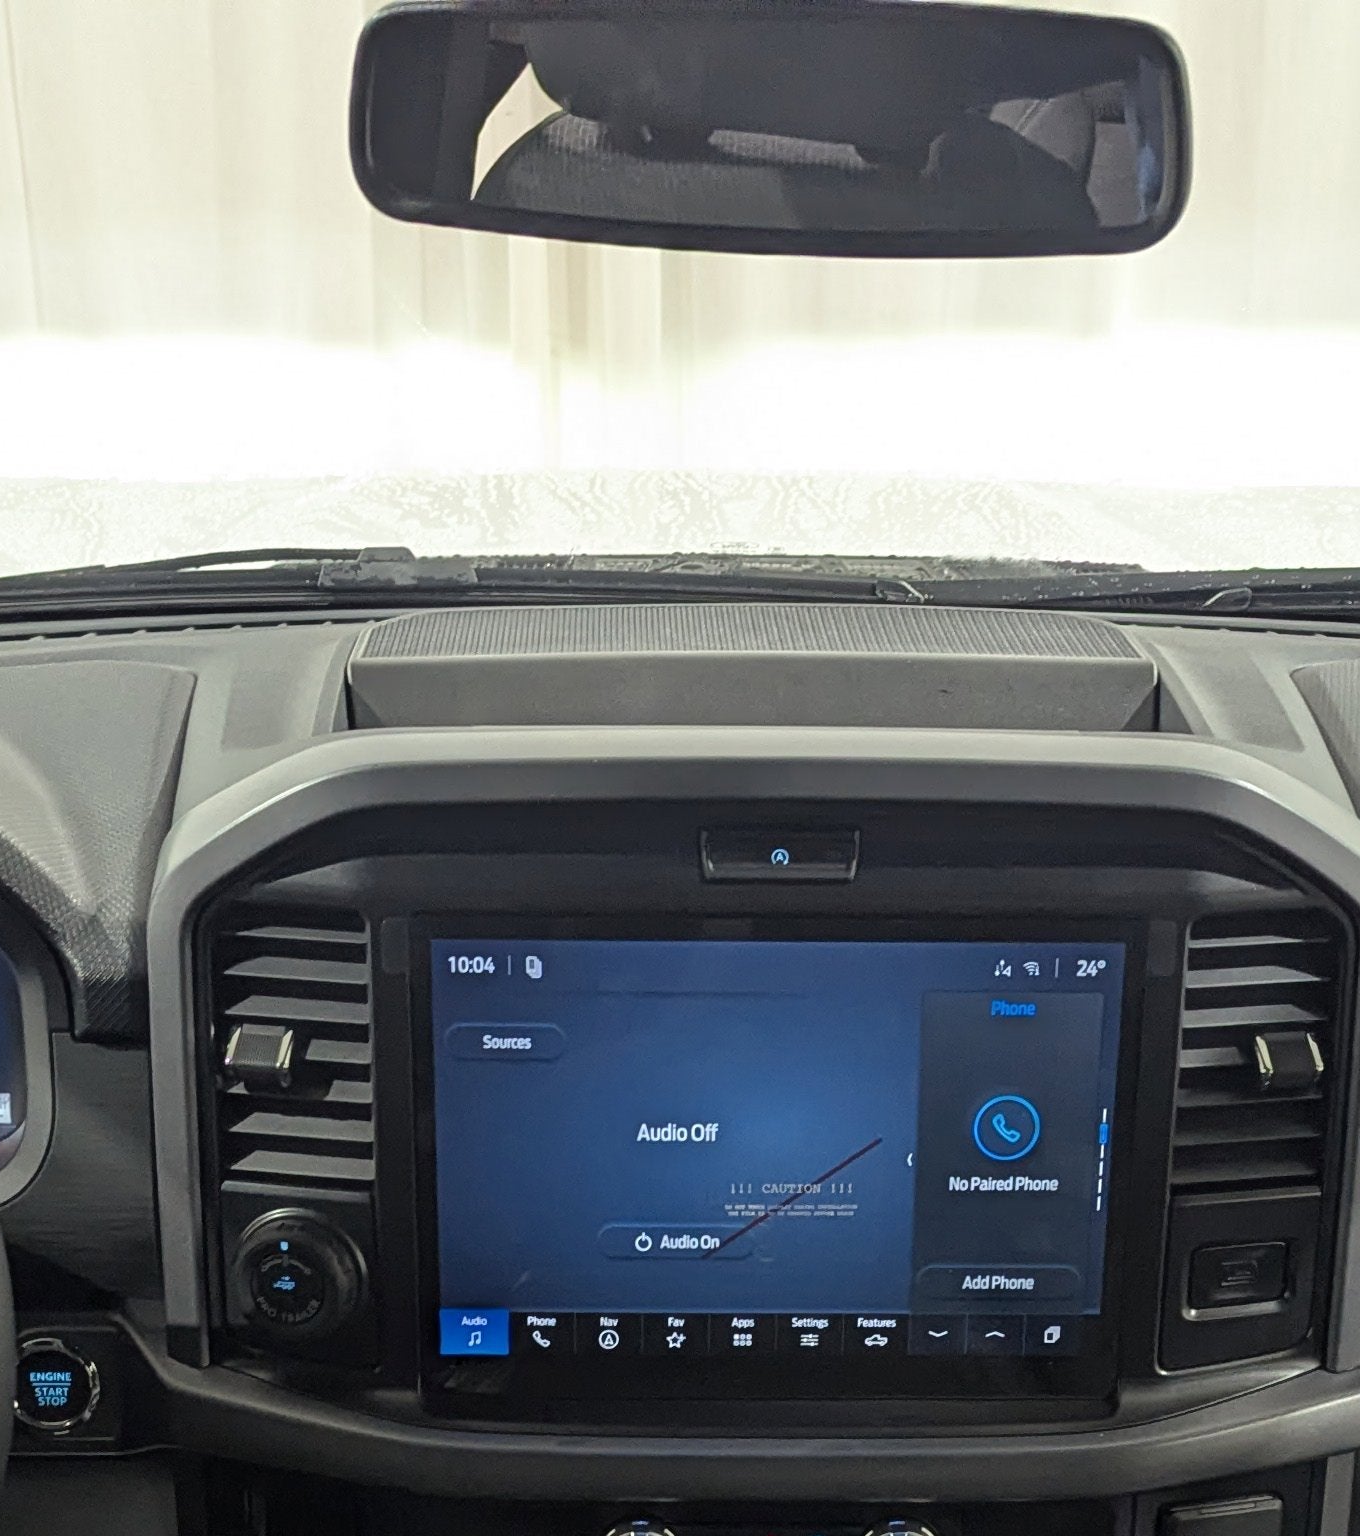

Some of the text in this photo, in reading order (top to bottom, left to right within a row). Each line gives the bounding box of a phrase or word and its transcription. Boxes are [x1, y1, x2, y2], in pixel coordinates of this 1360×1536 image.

[448, 956, 496, 974] 10:04
[1076, 959, 1107, 978] 24°
[991, 1000, 1037, 1016] Phone
[483, 1034, 532, 1049] Sources
[636, 1123, 719, 1142] Audio Off
[761, 1183, 821, 1195] CAUTION
[948, 1175, 1059, 1191] No Paired Phone
[659, 1234, 721, 1250] Audio On
[962, 1274, 1035, 1291] Add Phone
[461, 1316, 487, 1327] Audio
[527, 1316, 557, 1327] Phone
[600, 1316, 618, 1327] Nav
[668, 1316, 685, 1327] Fav
[731, 1317, 755, 1329] Apps
[791, 1316, 829, 1329] Settings
[857, 1317, 897, 1328] Features
[29, 1371, 72, 1382] ENGINE
[34, 1387, 69, 1397] START
[38, 1397, 67, 1407] STOP
